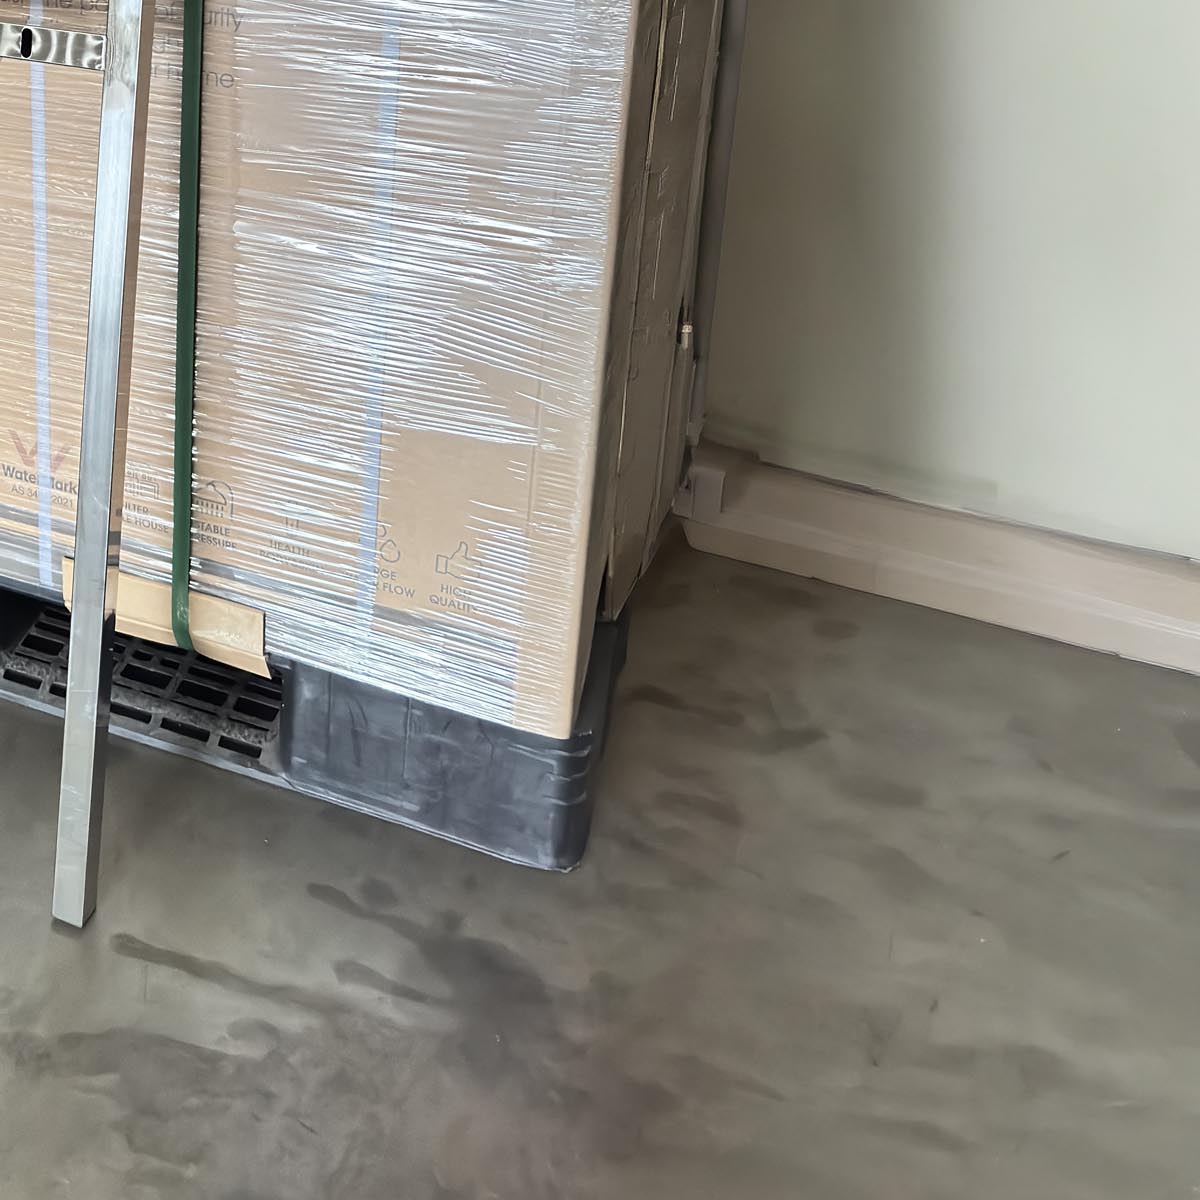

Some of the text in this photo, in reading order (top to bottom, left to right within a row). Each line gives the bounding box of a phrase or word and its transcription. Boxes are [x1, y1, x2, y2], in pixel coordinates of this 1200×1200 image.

[202, 7, 243, 32] urity
[2, 463, 78, 495] Wateark
[11, 485, 25, 495] AS
[123, 502, 149, 516] ILTER
[134, 516, 170, 534] HOUSE
[191, 531, 238, 550] RESSURE
[382, 582, 416, 600] FLOW
